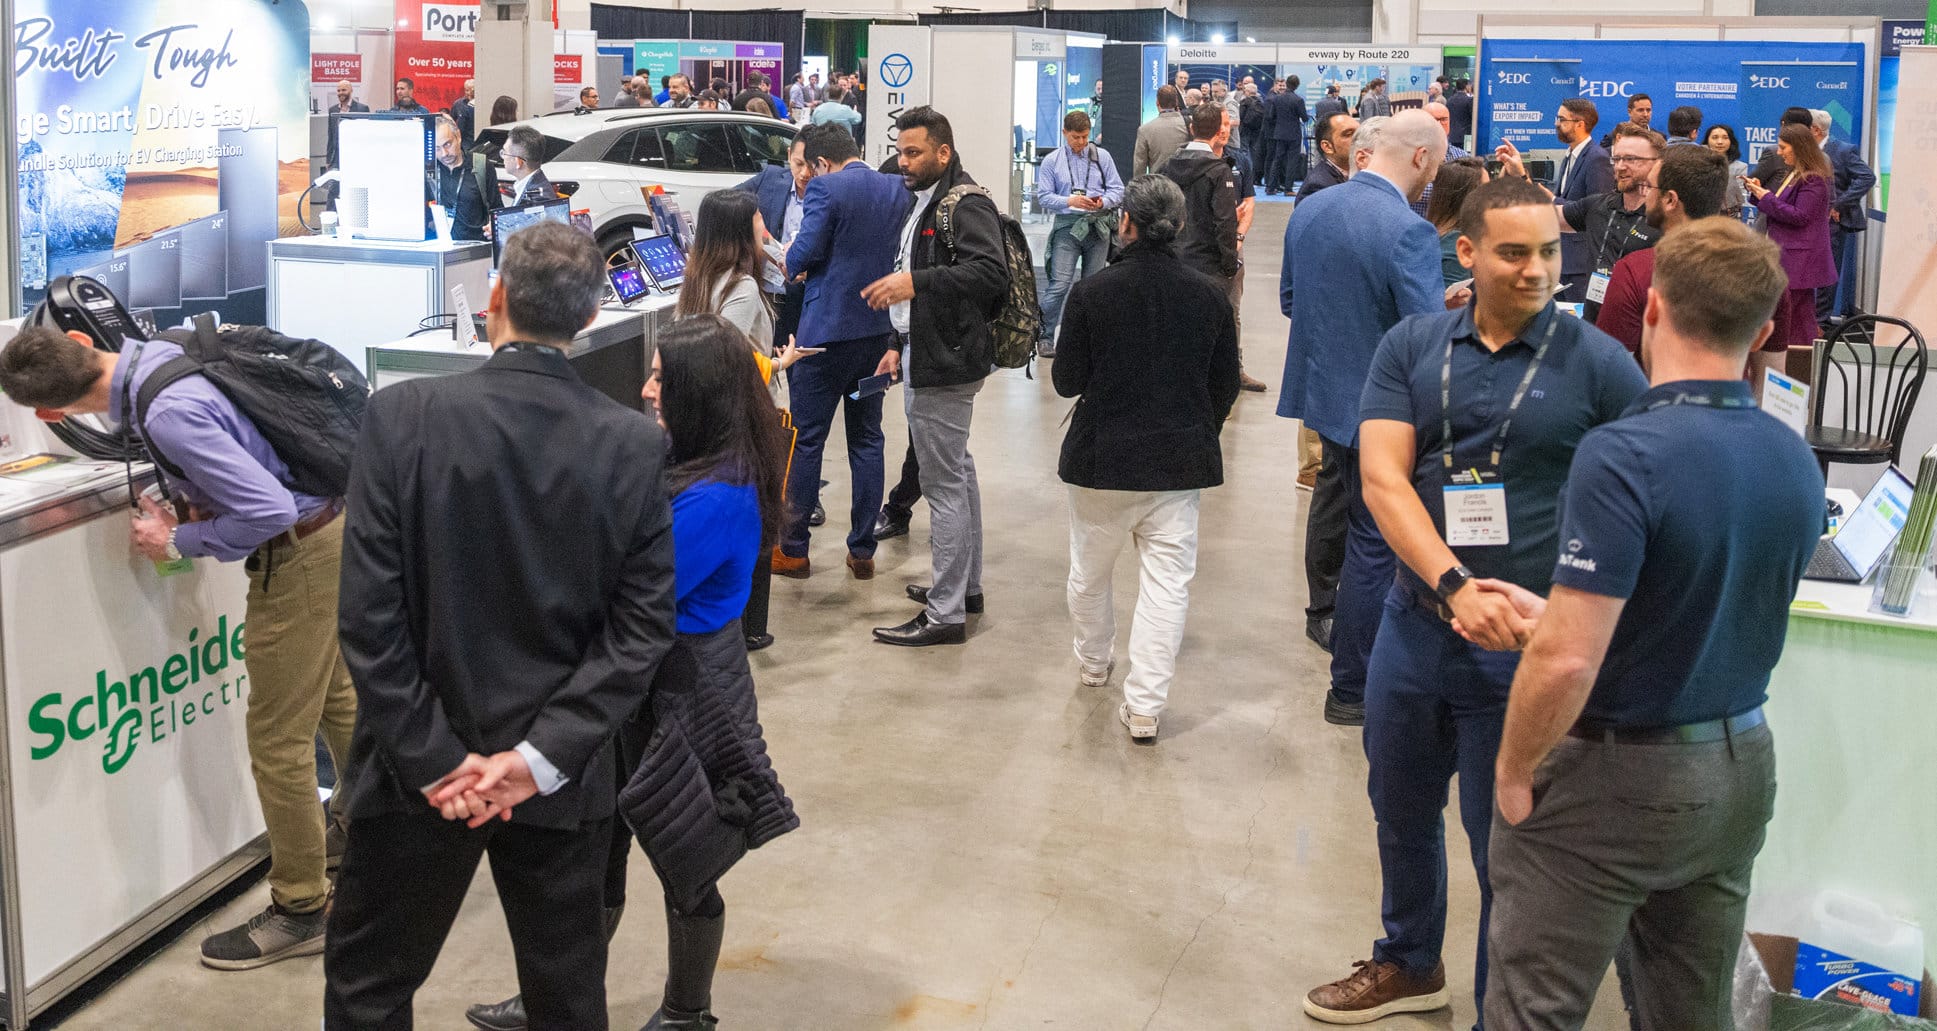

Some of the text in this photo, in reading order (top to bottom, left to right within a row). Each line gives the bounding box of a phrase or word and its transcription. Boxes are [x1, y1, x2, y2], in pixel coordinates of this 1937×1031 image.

[427, 8, 481, 32] Port
[1892, 38, 1920, 46] Energy
[16, 18, 238, 88] Built Tough
[1180, 49, 1217, 58] Deloitte
[1308, 50, 1409, 60] evway by Route 220
[314, 60, 360, 69] LIGHT POLE
[408, 57, 473, 70] Over 50 years
[324, 68, 350, 76] BASES
[1506, 73, 1532, 84] EDC
[1760, 77, 1791, 89] EDC
[1589, 80, 1635, 98] EDC
[1677, 83, 1736, 92] VOTRE PARTENAIRE
[1816, 81, 1848, 90] Canada
[1493, 102, 1527, 111] WHAT'S THE
[57, 105, 138, 137] Smart,
[146, 104, 205, 131] Drive
[211, 103, 261, 133] Easy.
[1495, 112, 1517, 120] EXPORT
[1744, 127, 1776, 142] TAKE
[58, 150, 112, 170] Solution
[116, 150, 133, 167] for
[136, 148, 152, 164] EV
[154, 145, 205, 167] Charging
[206, 143, 243, 160] Station
[28, 614, 247, 761] Schneide
[151, 674, 247, 745] Electr
